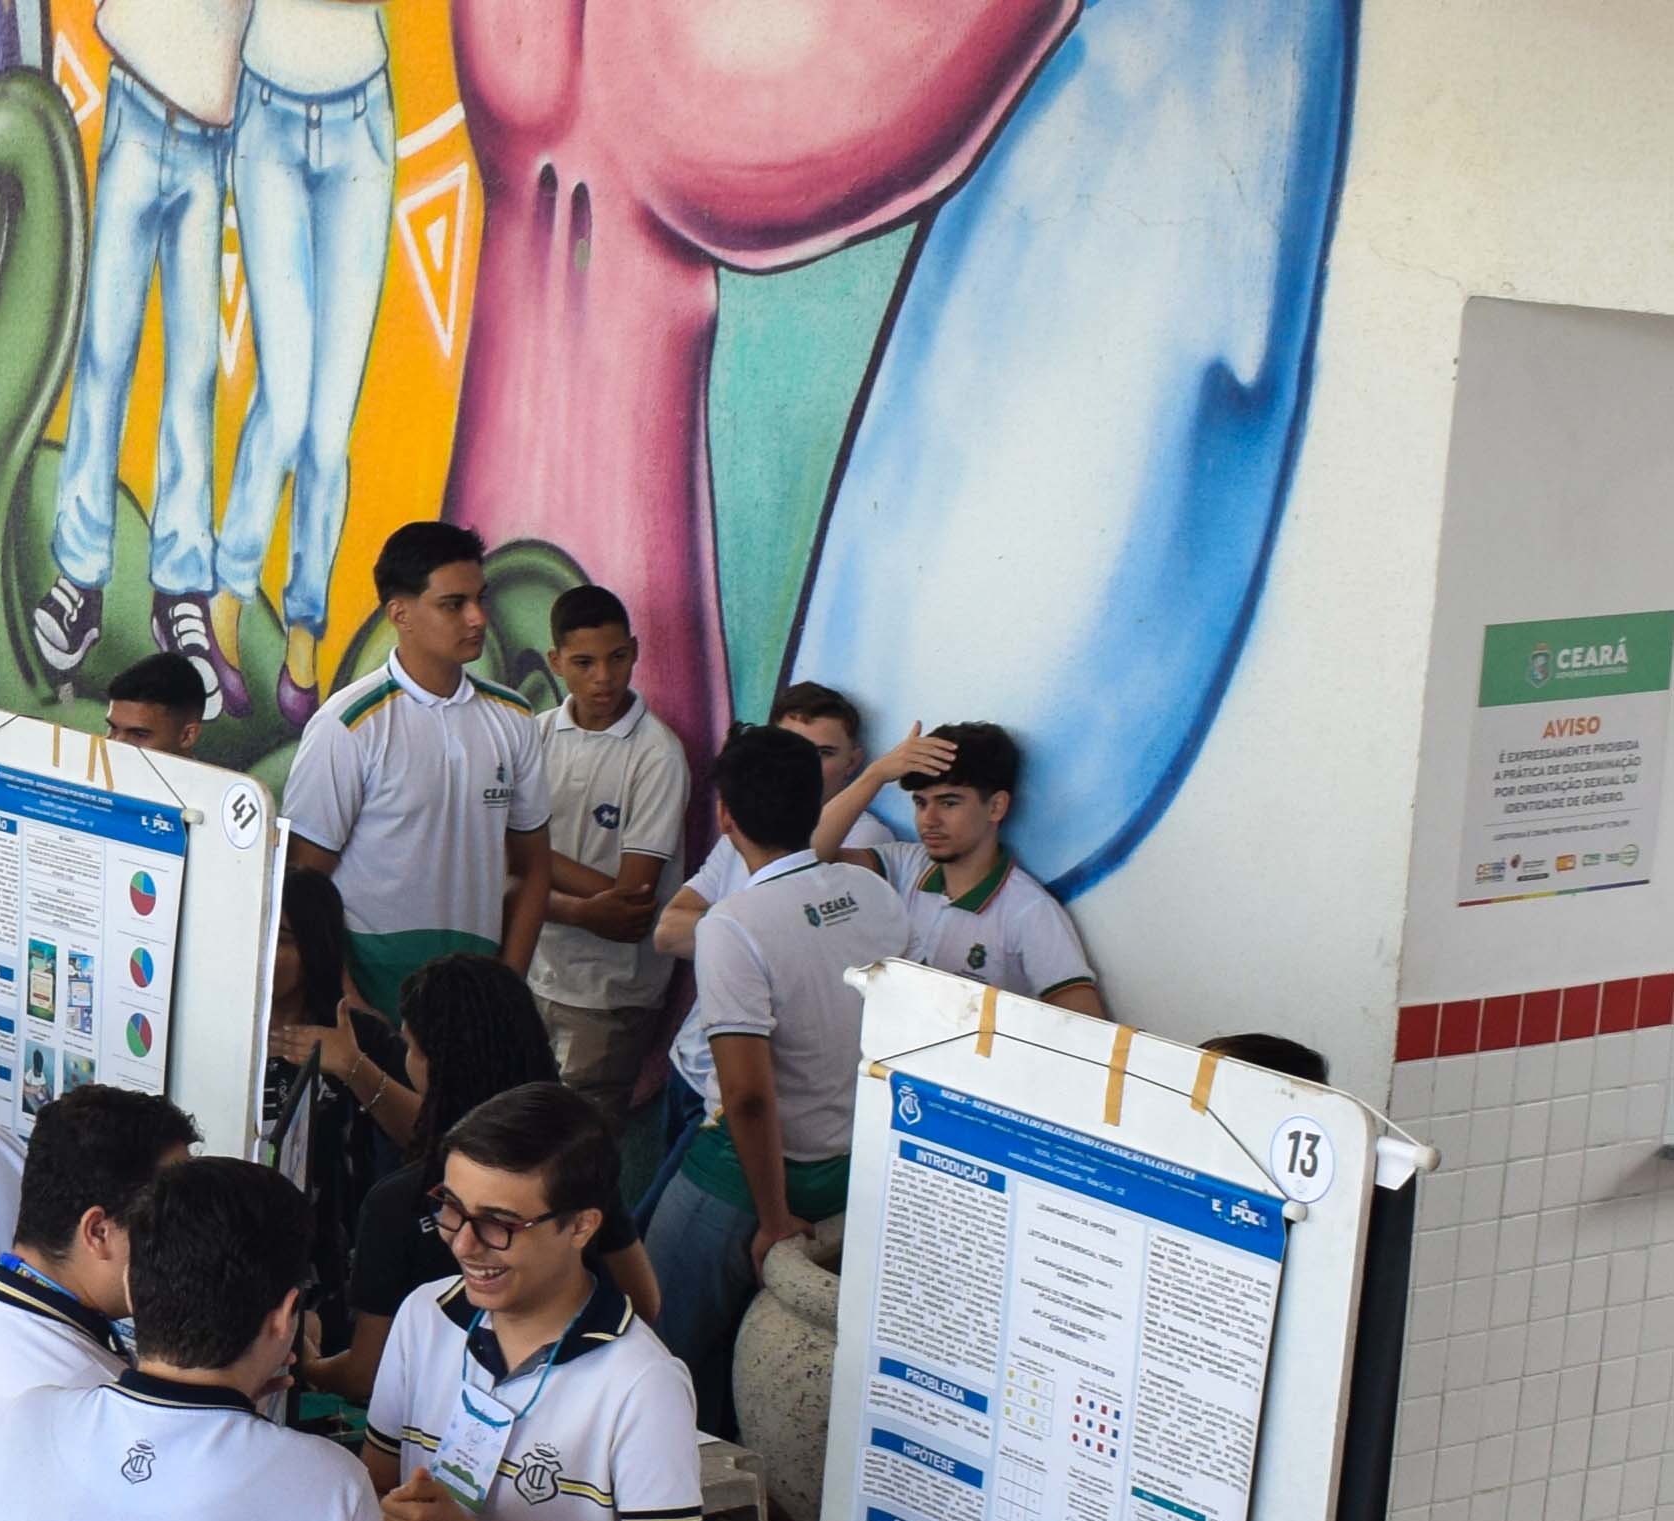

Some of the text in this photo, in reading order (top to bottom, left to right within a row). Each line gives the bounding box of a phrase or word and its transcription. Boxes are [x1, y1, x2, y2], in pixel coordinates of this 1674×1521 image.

[1556, 636, 1629, 669] CEARÁ
[1543, 716, 1602, 738] AVISO
[1494, 787, 1516, 798] POR
[1518, 777, 1582, 796] ORIENTAÇÃO
[1622, 773, 1638, 784] OU
[1503, 765, 1545, 780] PRÁTICA
[1547, 765, 1560, 776] DE
[1504, 798, 1564, 814] IDENTIDADE
[1566, 796, 1580, 807] DE
[916, 1149, 988, 1185] INTRODUÇÃO
[1287, 1129, 1322, 1178] 13
[905, 1367, 966, 1403] PROBLEMA
[902, 1441, 956, 1475] HIPÓTESE
